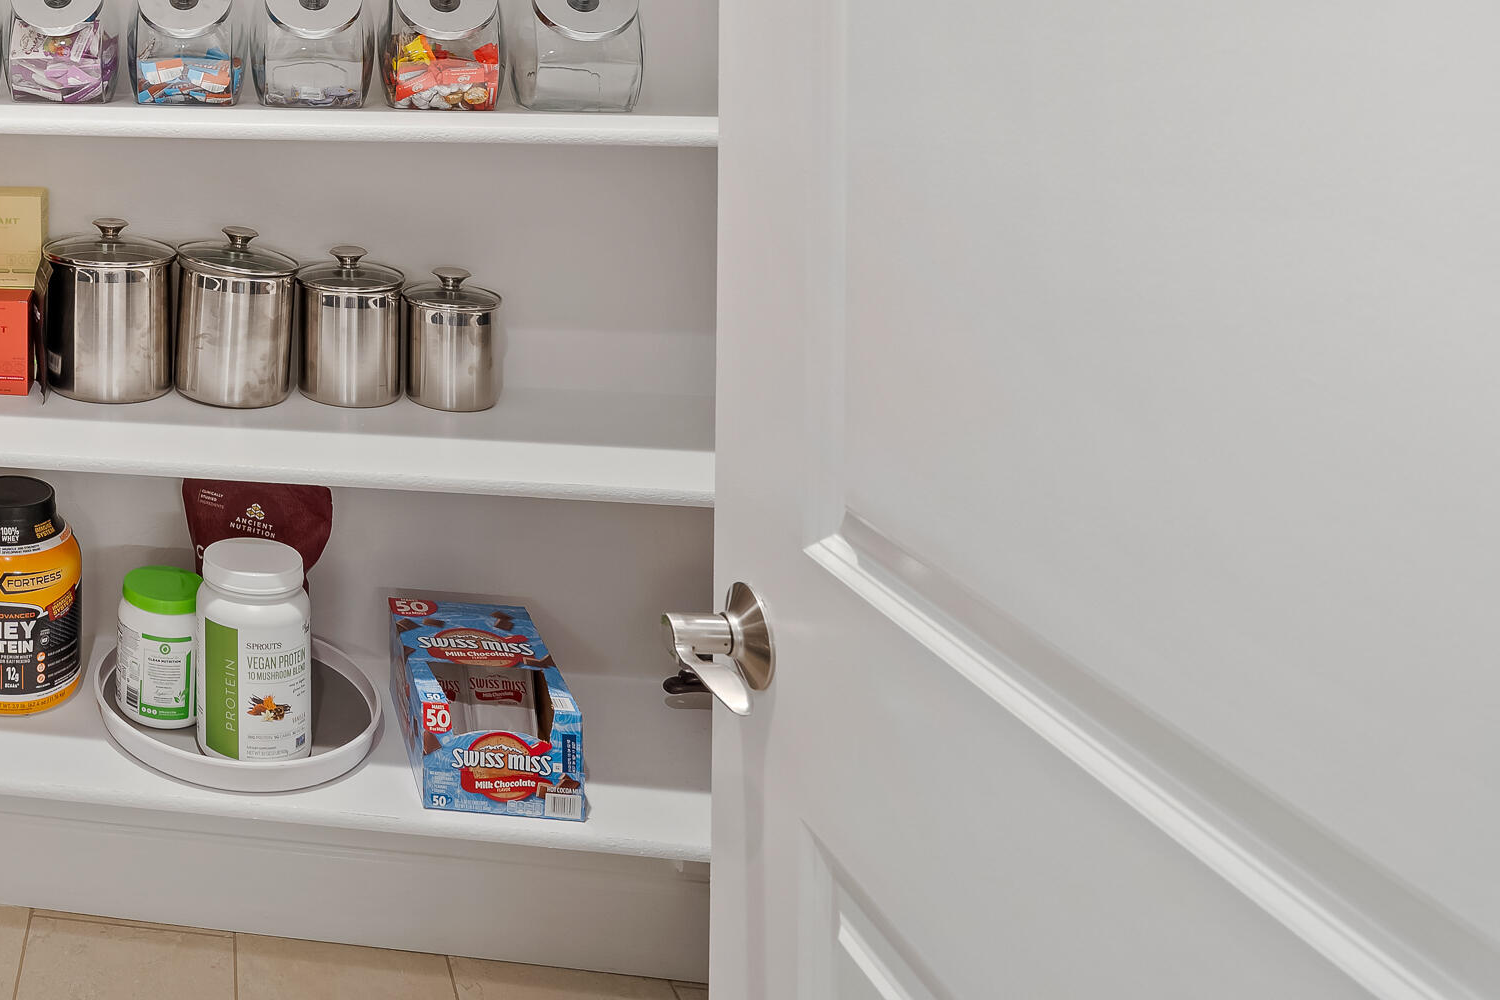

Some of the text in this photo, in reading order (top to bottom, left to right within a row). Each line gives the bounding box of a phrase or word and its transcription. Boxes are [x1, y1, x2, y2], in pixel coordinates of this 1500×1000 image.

[0, 526, 20, 536] 100%
[229, 521, 276, 539] NUTRITION
[235, 516, 274, 531] ANCIENT
[7, 570, 62, 588] FORTRESS
[395, 600, 429, 612] 50
[246, 642, 283, 651] SPROUTS
[247, 647, 306, 670] VEGAN PROTEIN
[6, 666, 20, 682] 12g
[248, 662, 306, 681] 10 MUSHROOM BLEND
[225, 659, 236, 732] PROTEIN
[426, 709, 450, 728] 50
[475, 778, 536, 789] Milk Chocolate
[432, 795, 447, 807] 50
